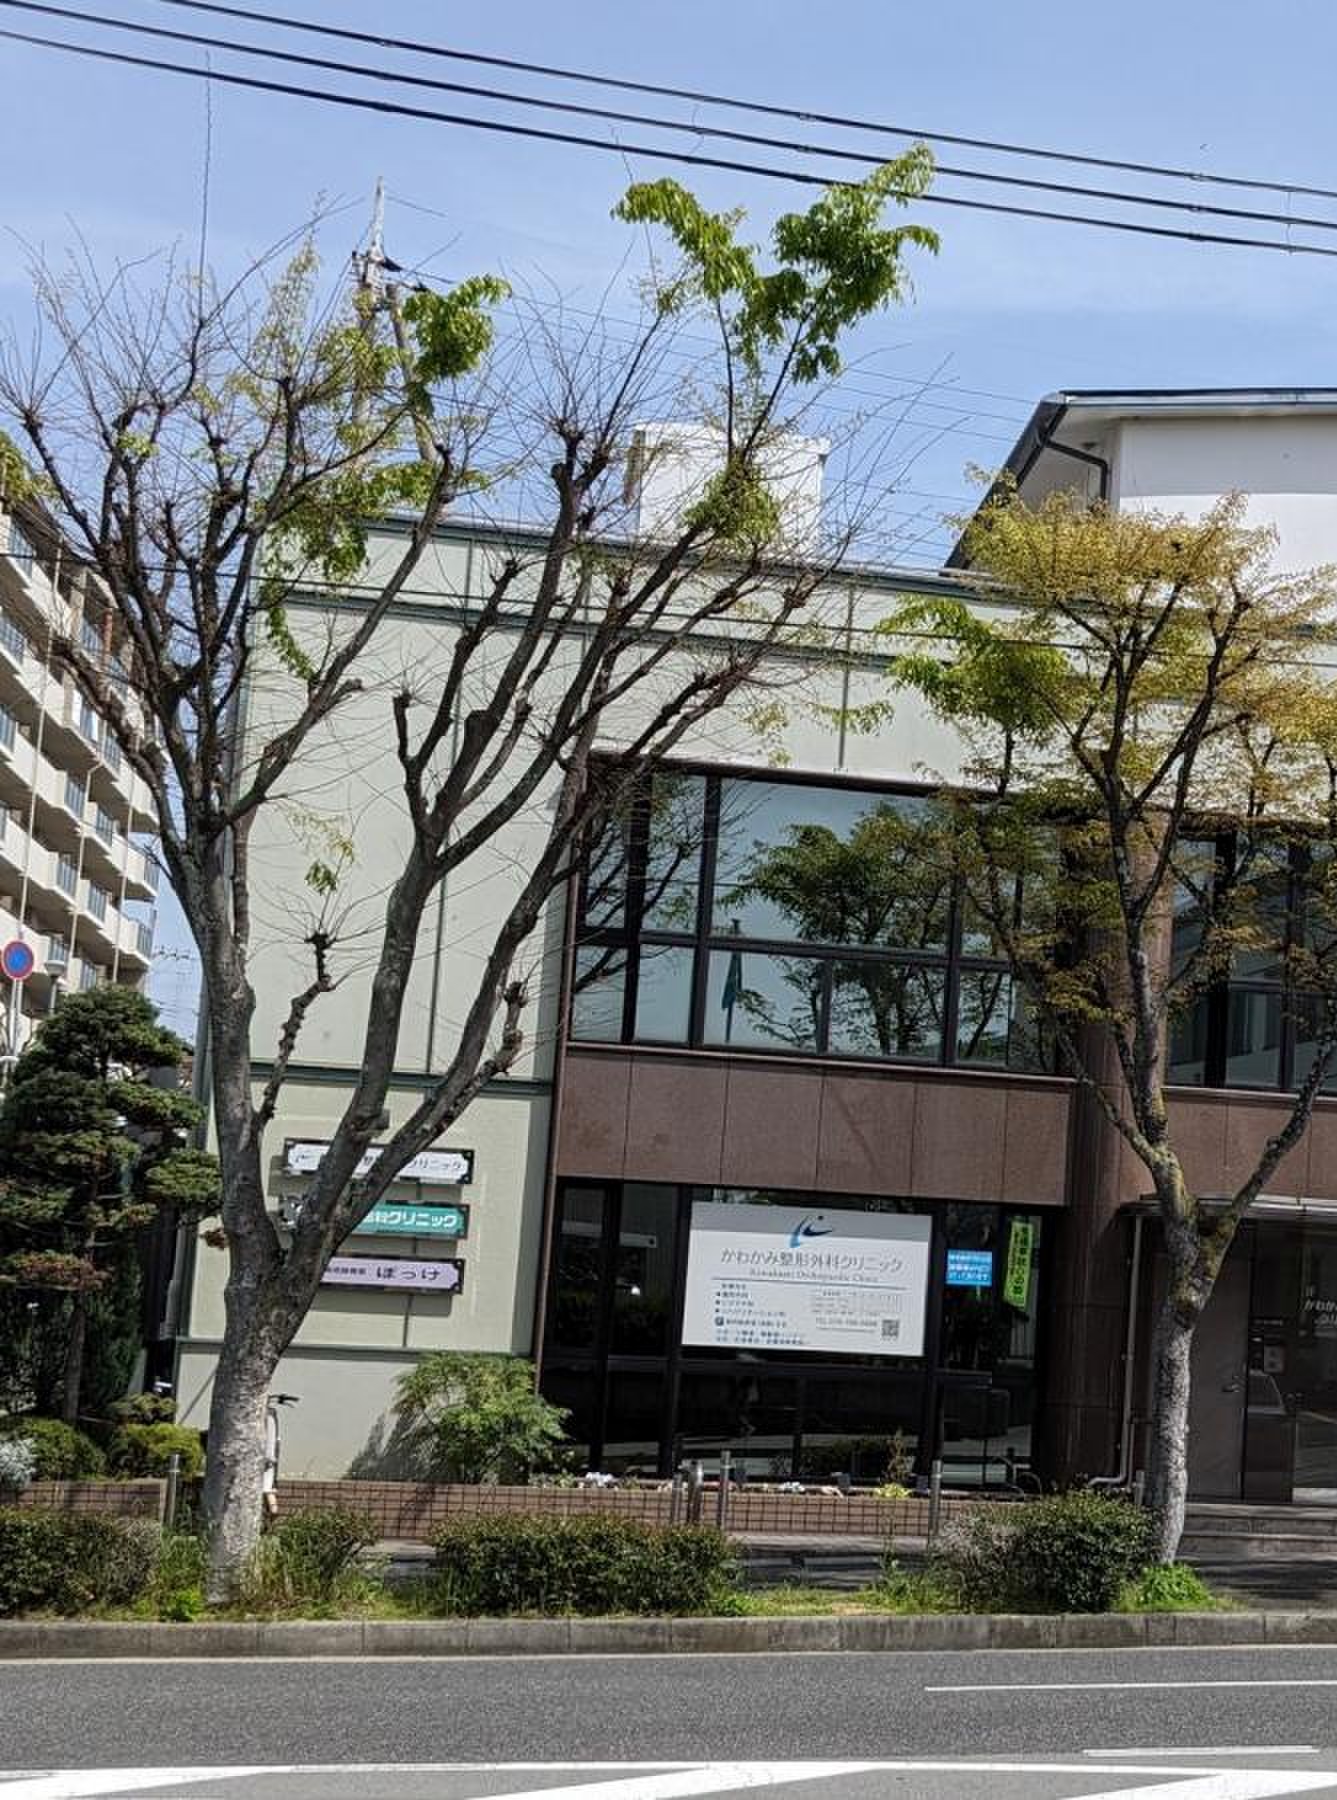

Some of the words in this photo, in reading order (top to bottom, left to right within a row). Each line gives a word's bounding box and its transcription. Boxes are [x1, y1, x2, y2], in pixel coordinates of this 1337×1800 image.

[721, 1248, 904, 1273] かわかみ整形外科クリニック
